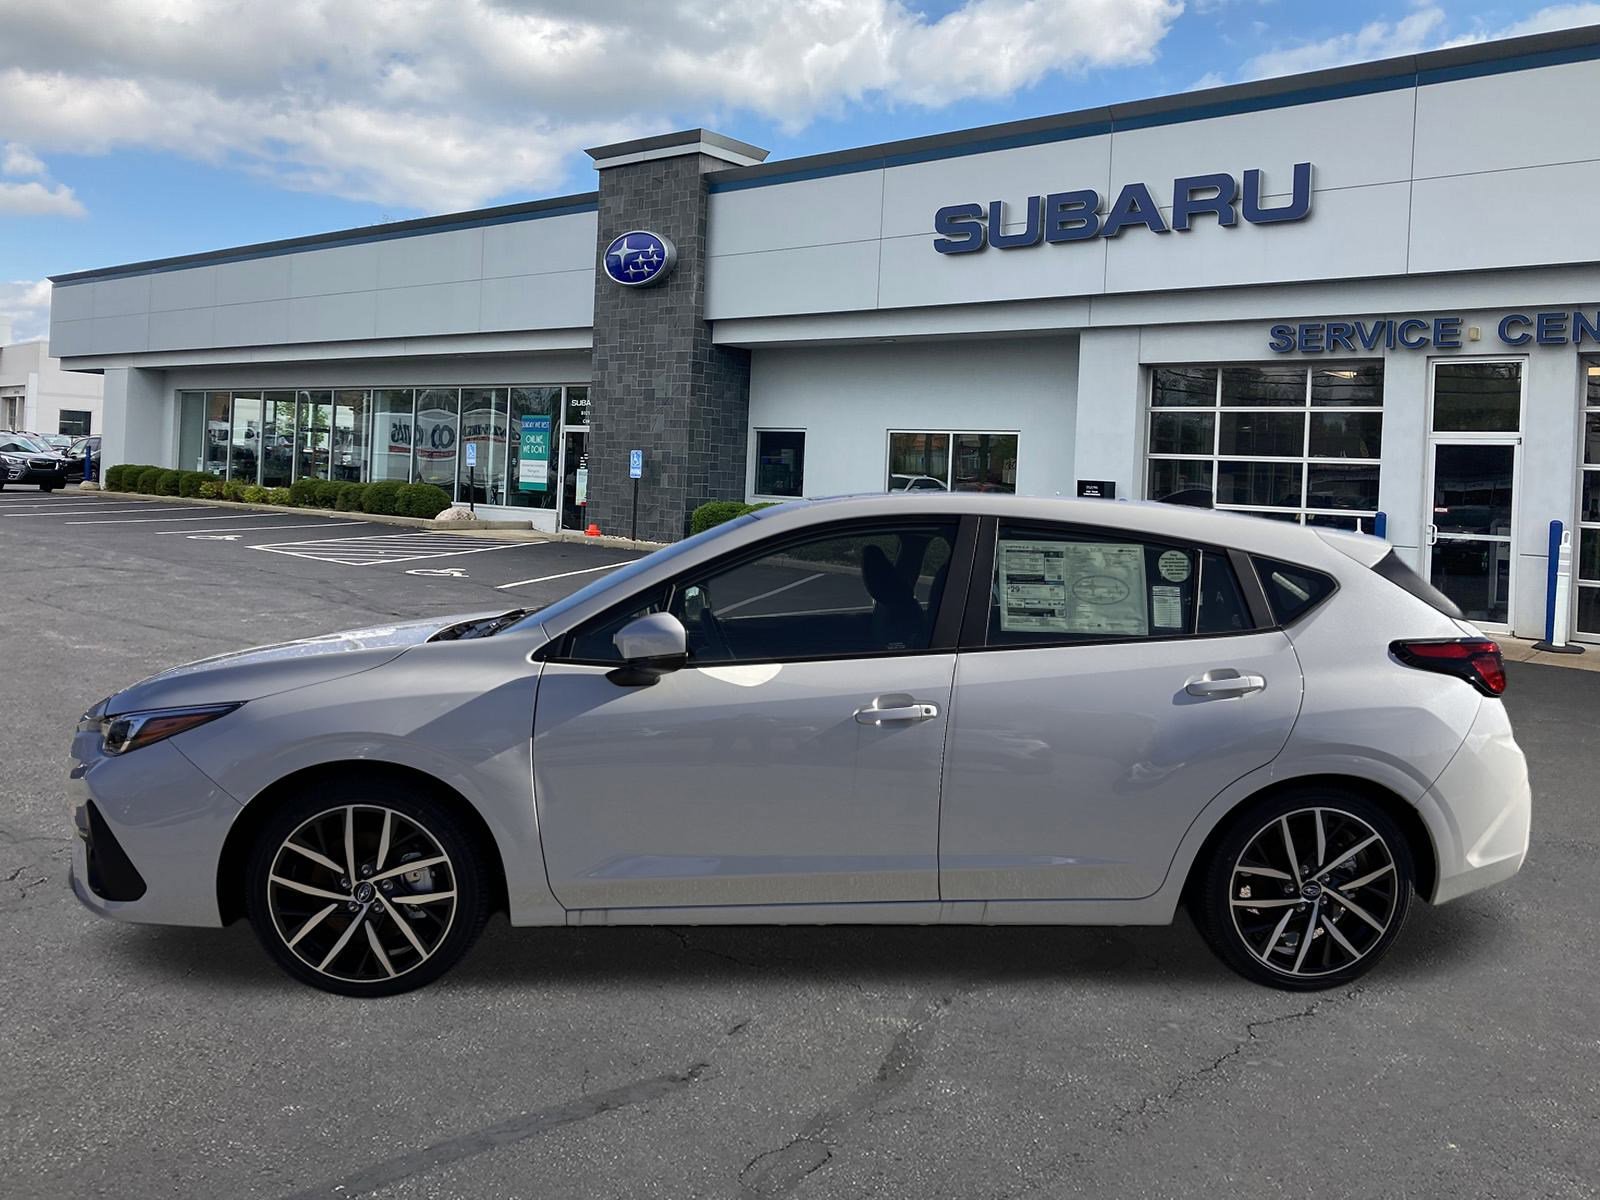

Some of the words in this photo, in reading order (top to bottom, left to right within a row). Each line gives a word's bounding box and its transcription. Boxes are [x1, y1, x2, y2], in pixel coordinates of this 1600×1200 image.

[933, 162, 1312, 255] SUBARU
[1269, 317, 1463, 352] SERVICE
[1497, 311, 1600, 345] CEN
